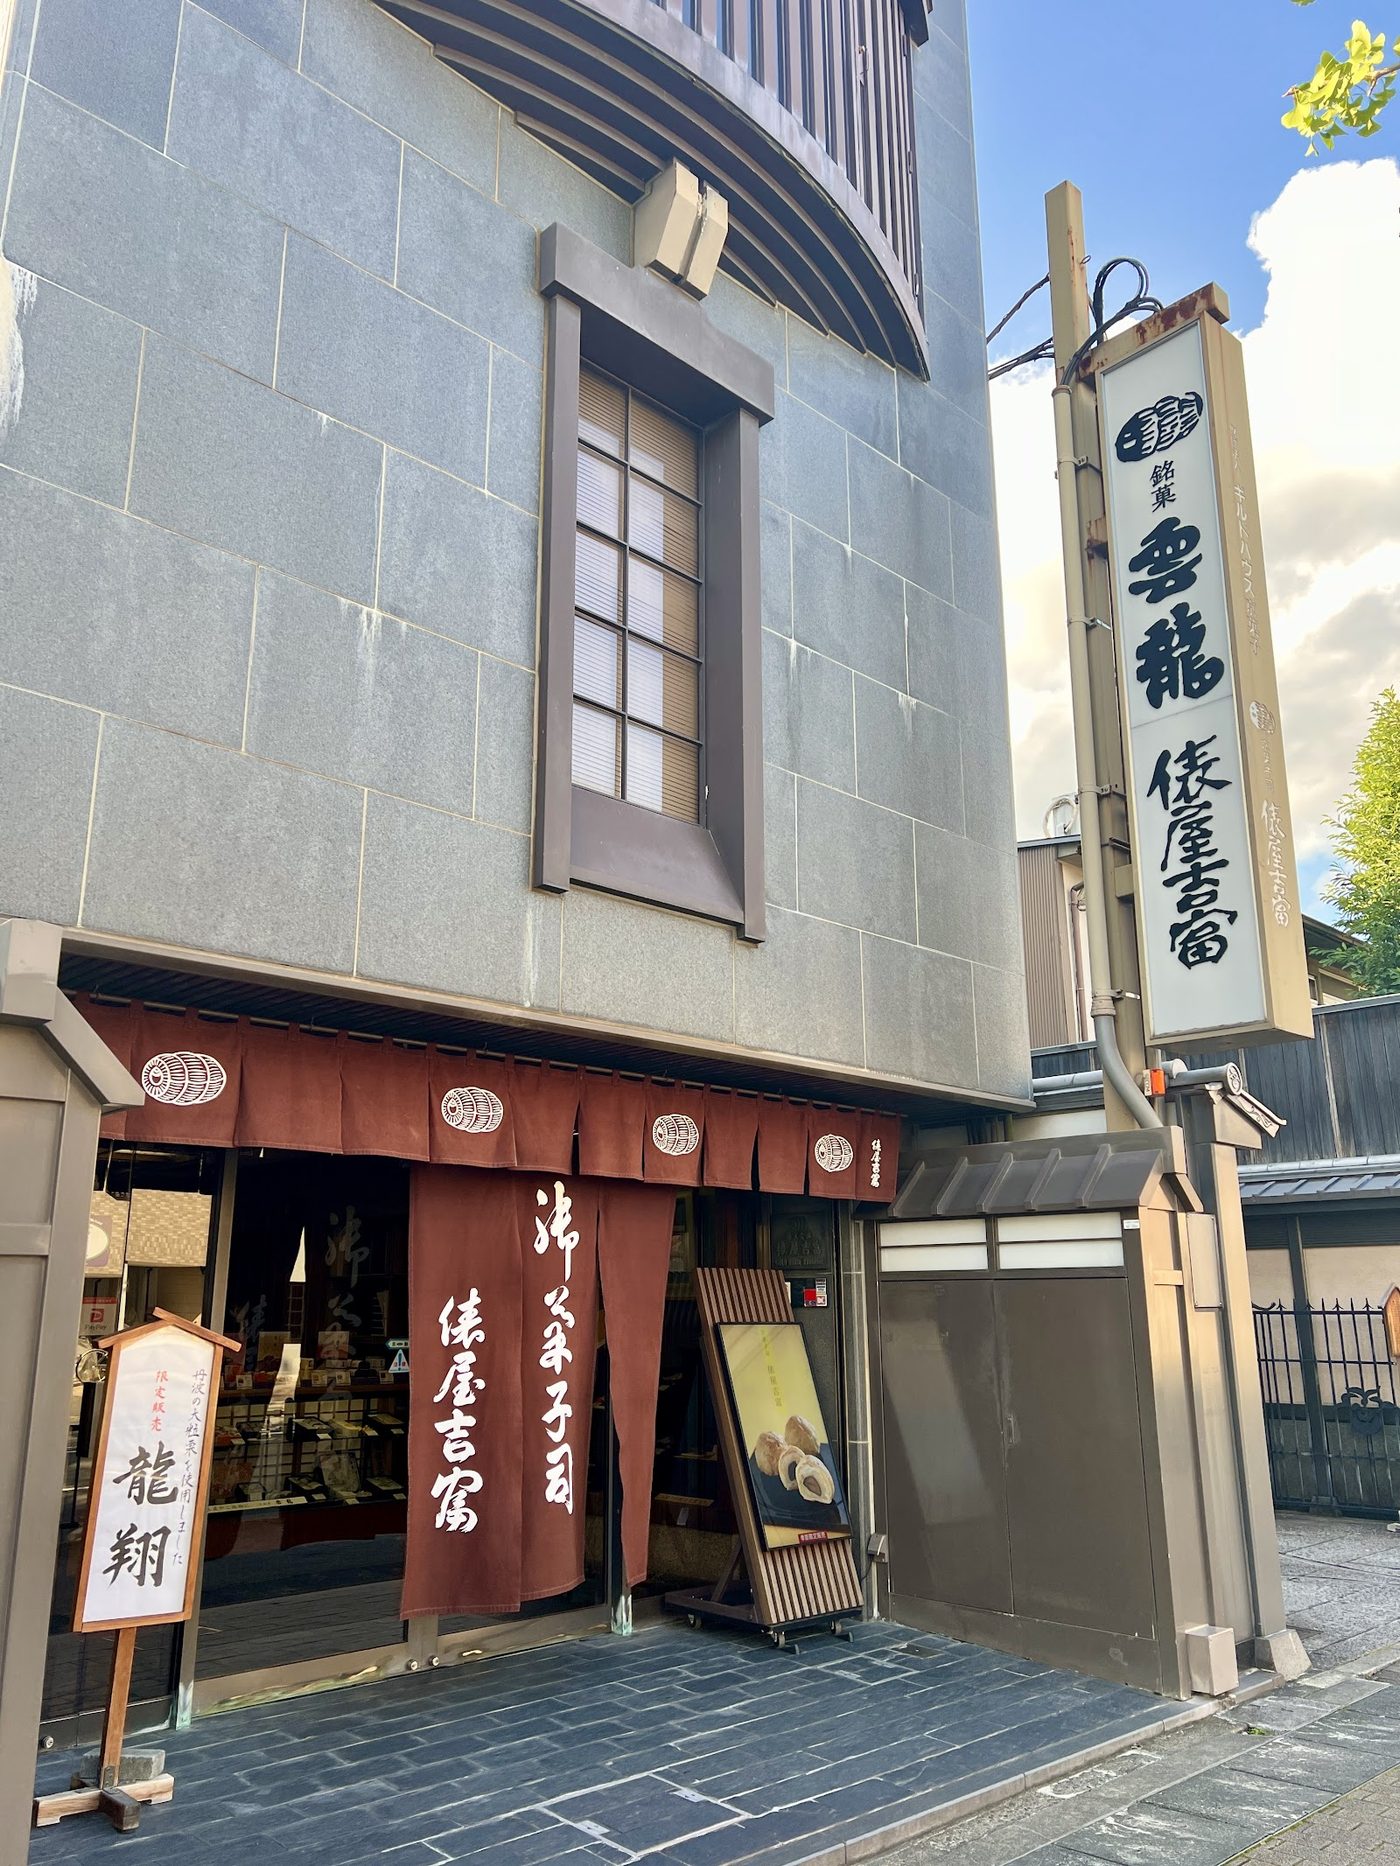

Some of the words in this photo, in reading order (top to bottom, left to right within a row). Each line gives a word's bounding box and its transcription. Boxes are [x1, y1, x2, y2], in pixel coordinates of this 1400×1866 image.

[1149, 459, 1177, 513] 銘菓
[1127, 515, 1226, 710] 雲龍
[1146, 734, 1239, 971] 俵屋吉富
[1260, 799, 1292, 929] 俵屋吉富
[150, 1369, 169, 1433] 限定販売
[430, 1287, 487, 1535] 俵屋吉富
[102, 1439, 179, 1589] 龍翔
